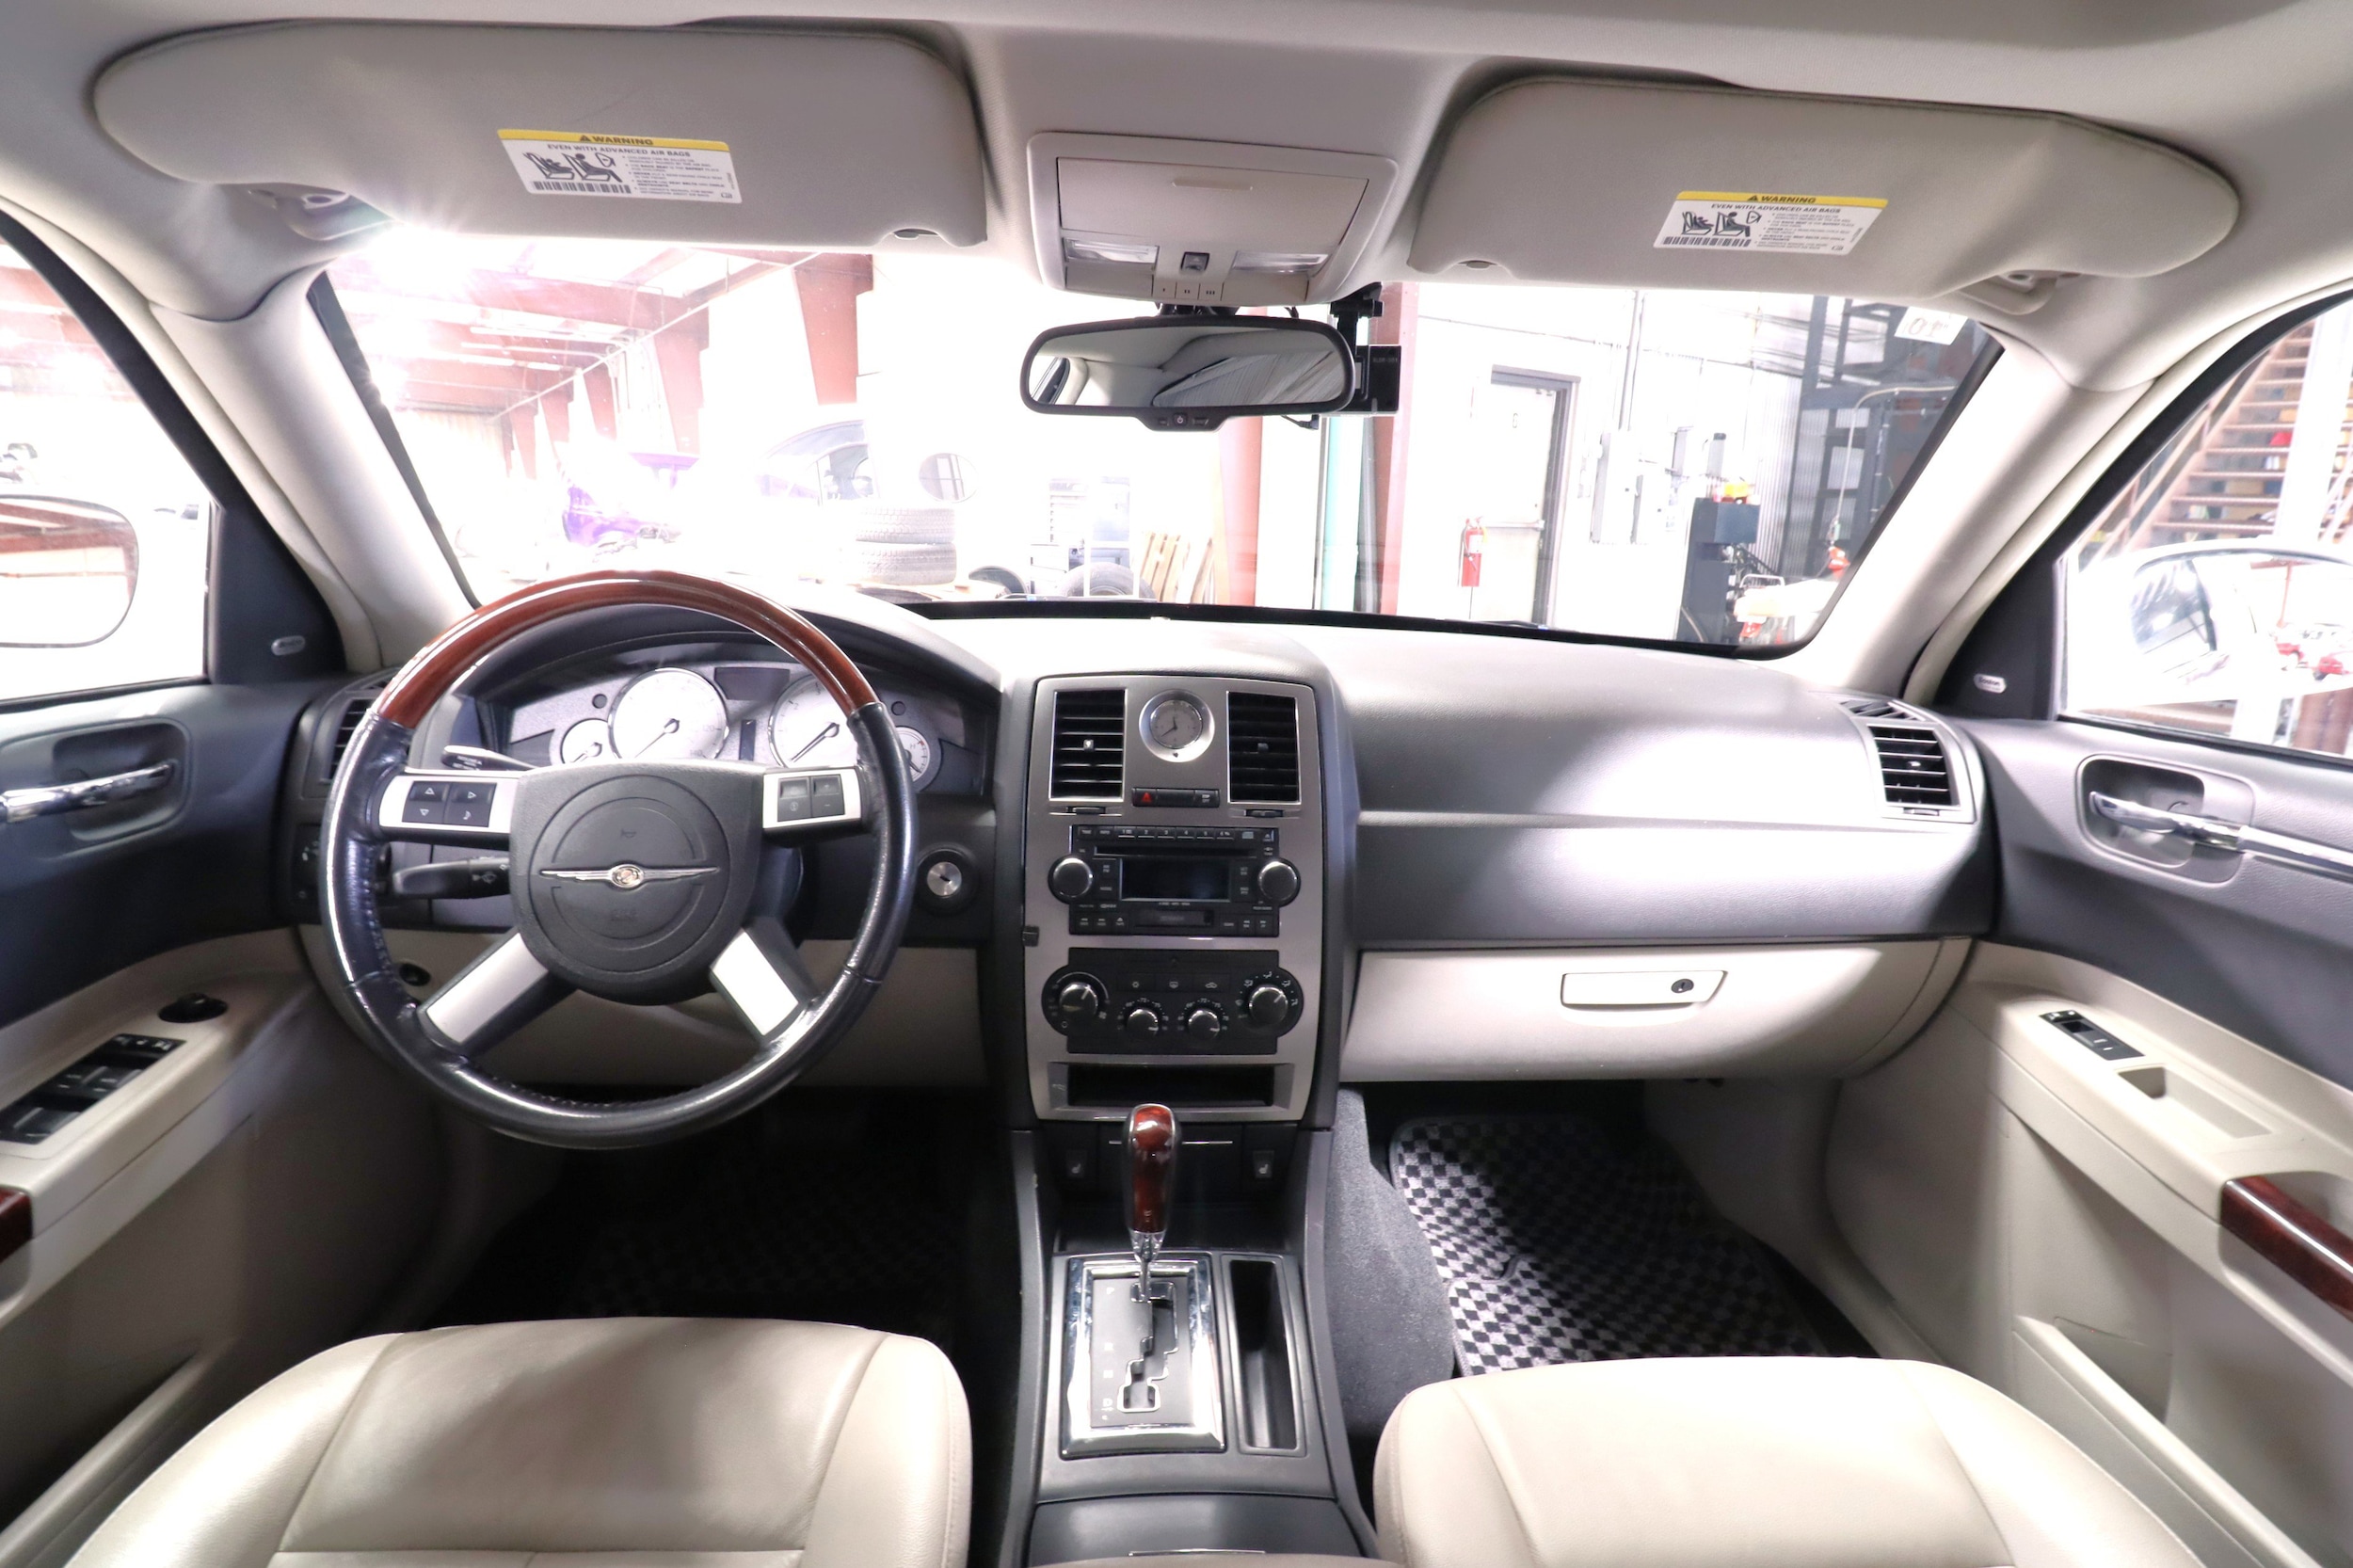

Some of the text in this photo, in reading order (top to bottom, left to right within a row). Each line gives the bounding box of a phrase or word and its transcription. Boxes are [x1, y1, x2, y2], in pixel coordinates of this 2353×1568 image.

[591, 136, 654, 146] WARNING
[1761, 195, 1817, 204] WARNING
[1106, 1287, 1114, 1295] P
[1102, 1398, 1113, 1407] D
